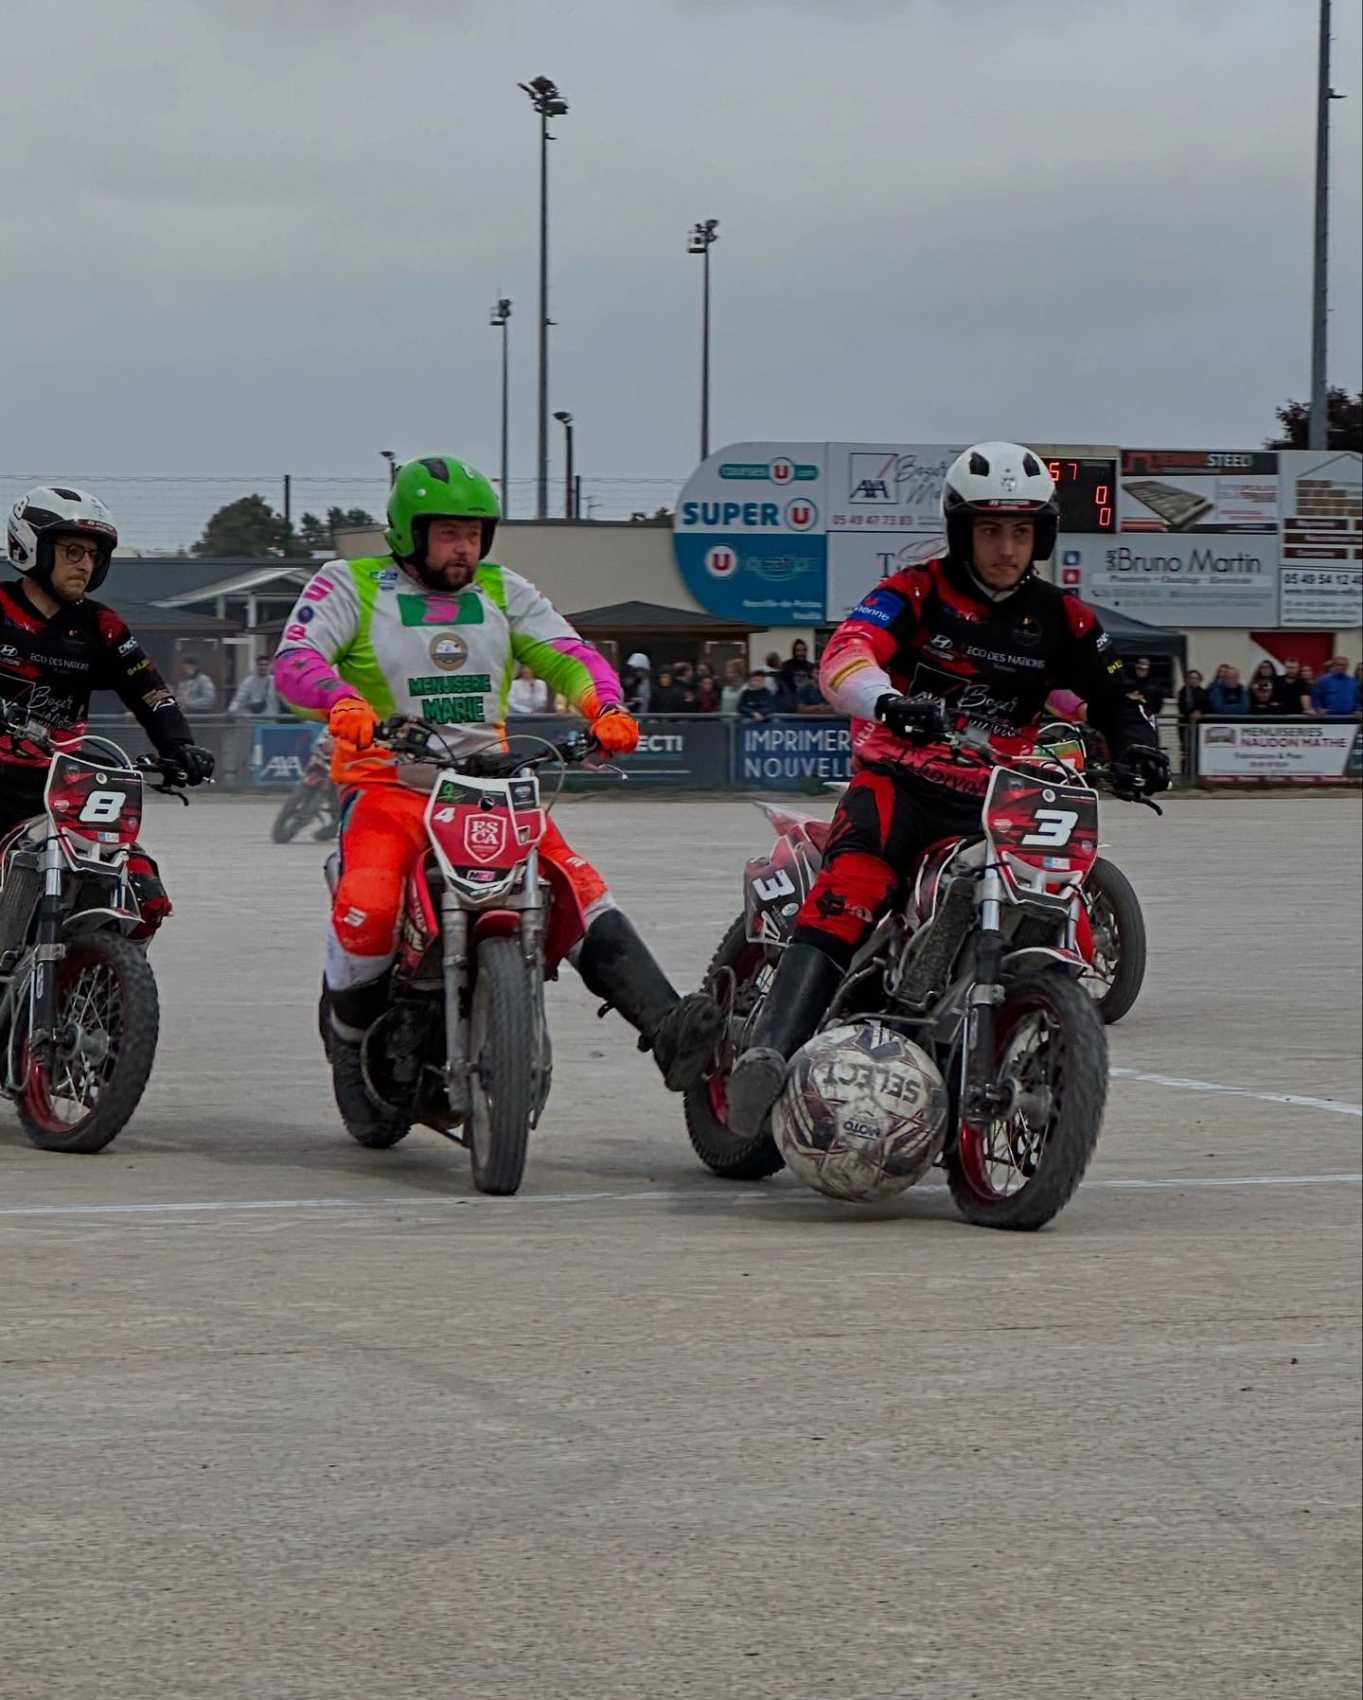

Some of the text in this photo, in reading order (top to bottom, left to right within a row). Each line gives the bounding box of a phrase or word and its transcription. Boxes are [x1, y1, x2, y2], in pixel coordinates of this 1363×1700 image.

[850, 479, 889, 499] AXA
[1096, 486, 1107, 504] 0
[682, 501, 779, 527] SUPER
[1099, 508, 1111, 526] 0
[1118, 547, 1182, 572] Bruno
[1188, 549, 1262, 573] Martin
[79, 790, 127, 823] 8
[434, 807, 456, 823] 4
[1021, 809, 1079, 847] 3
[751, 868, 796, 901] 3
[822, 1063, 921, 1105] SELECT
